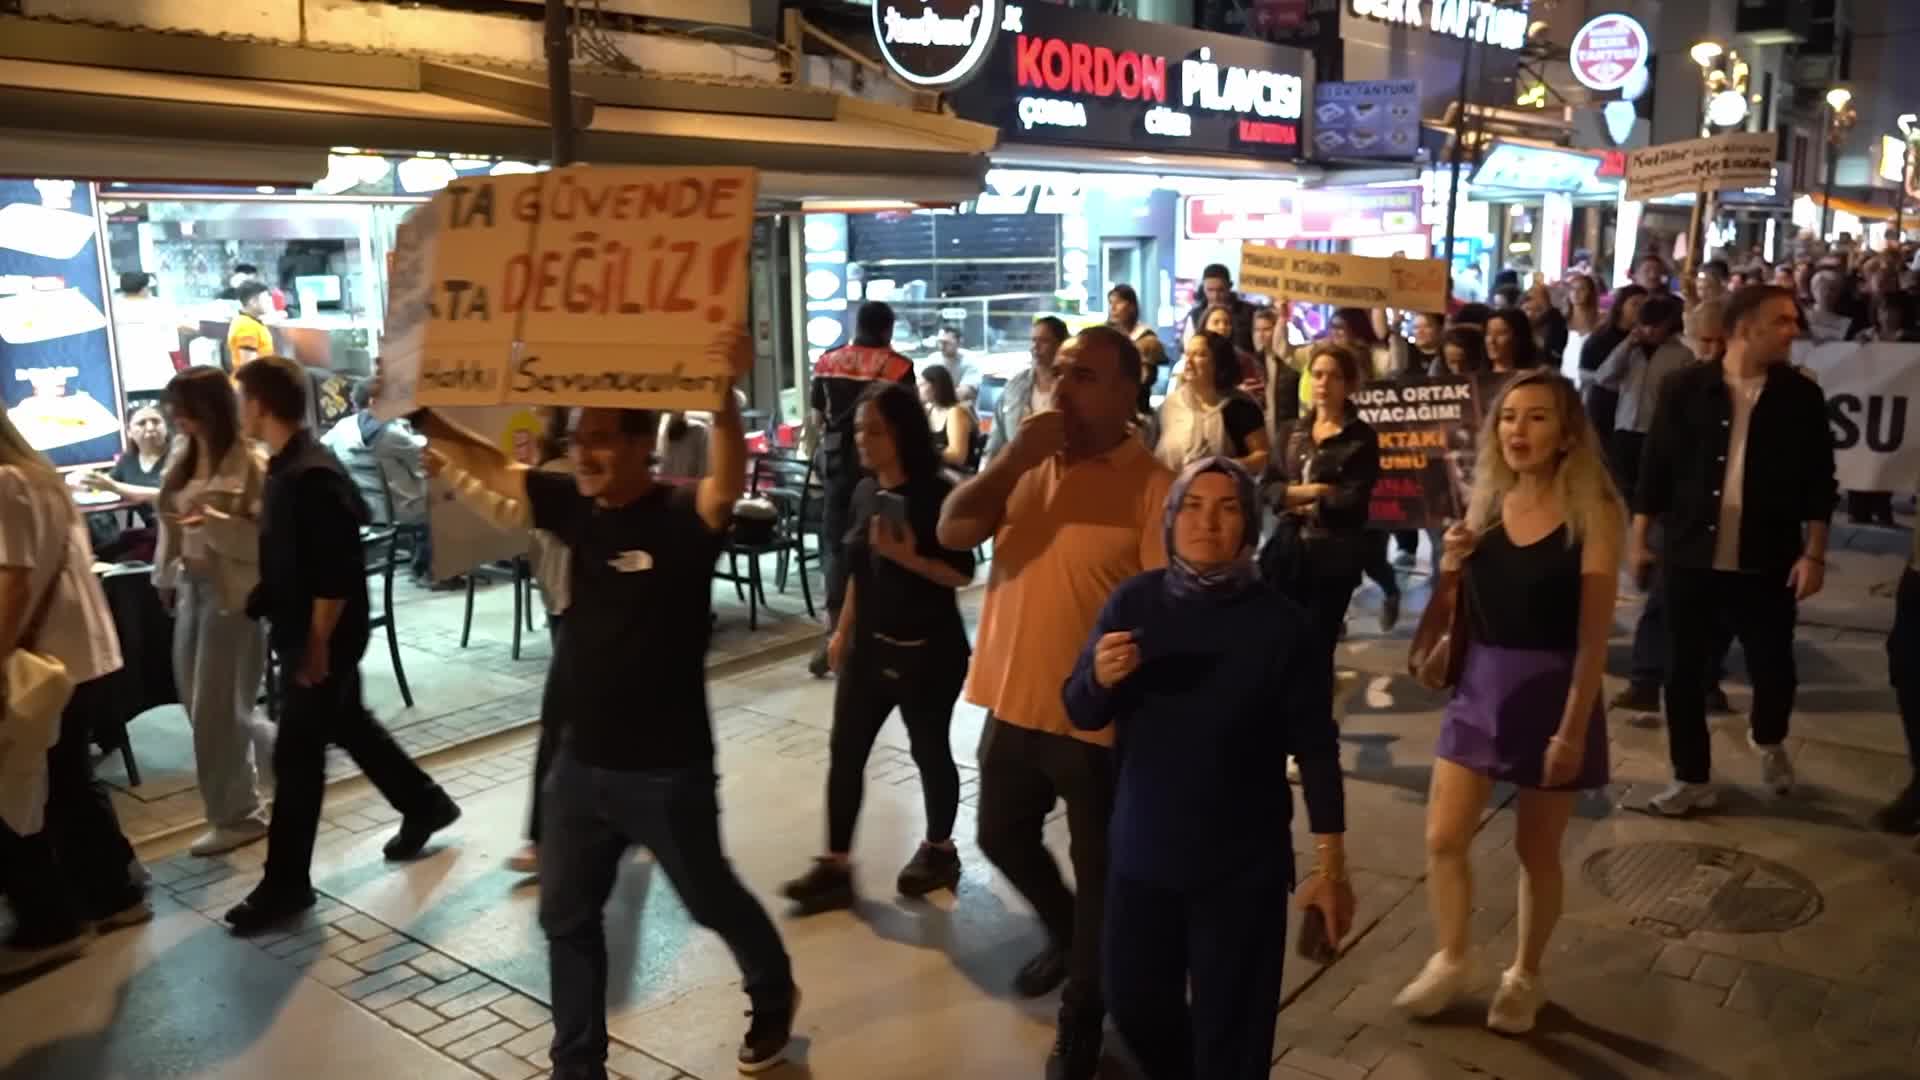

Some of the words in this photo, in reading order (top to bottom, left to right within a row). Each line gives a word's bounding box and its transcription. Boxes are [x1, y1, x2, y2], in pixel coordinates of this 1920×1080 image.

[1016, 35, 1167, 102] KORDON
[1182, 47, 1302, 119] PİLAVCISI
[512, 176, 743, 223] GÜVENDE
[426, 279, 490, 320] TA
[501, 232, 741, 323] DEĞİLİZ!
[1403, 385, 1471, 402] ORTAK
